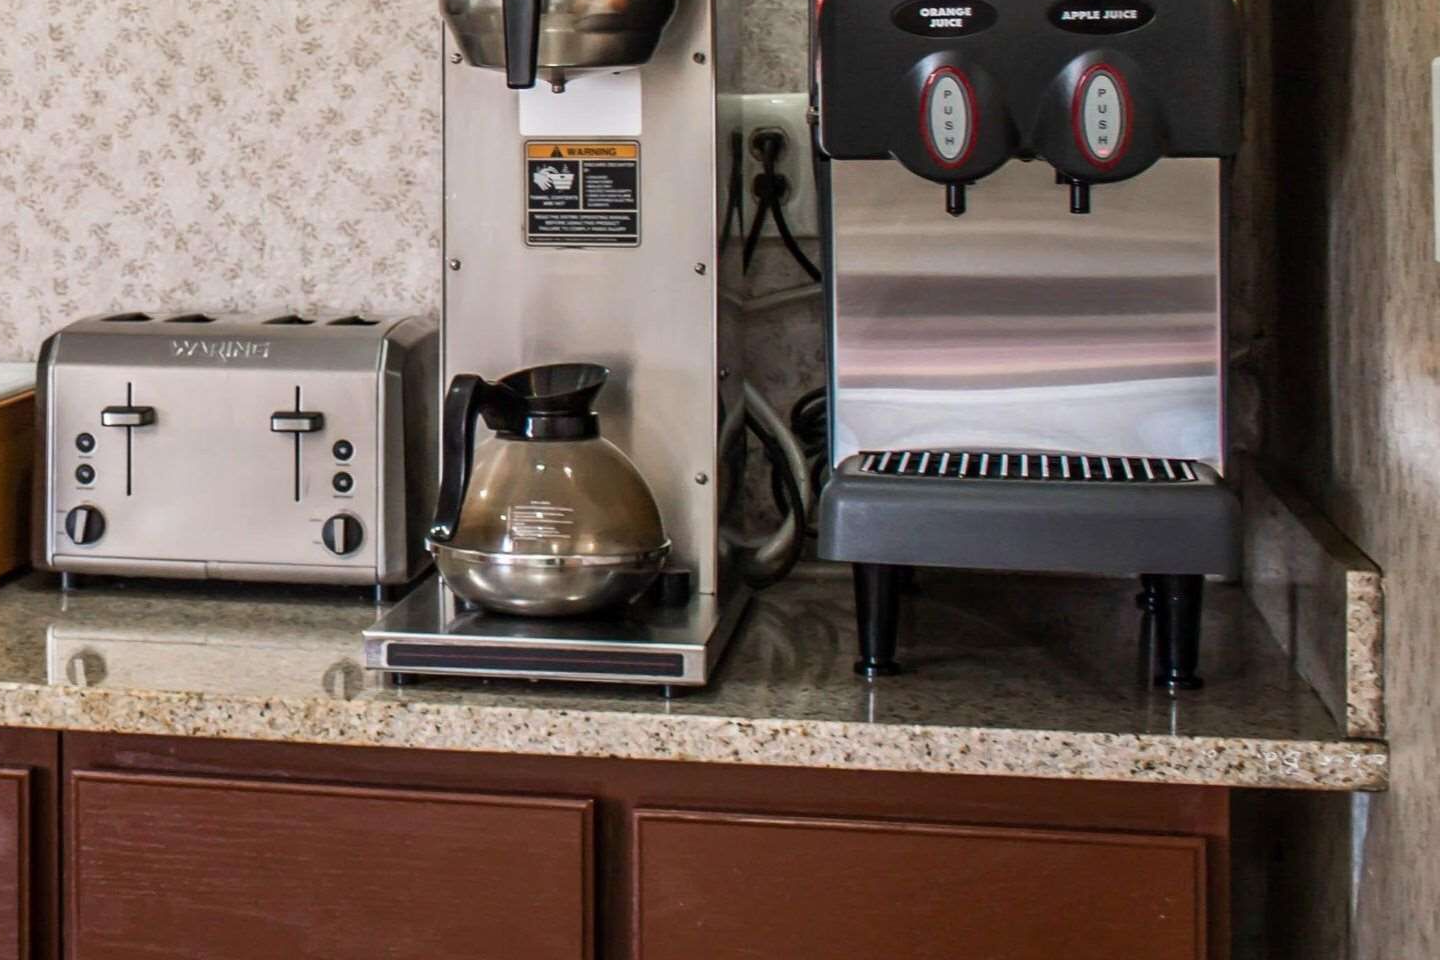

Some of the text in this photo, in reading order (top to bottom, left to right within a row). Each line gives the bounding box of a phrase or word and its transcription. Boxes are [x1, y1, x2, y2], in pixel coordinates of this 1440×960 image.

[919, 6, 972, 18] ORANGE
[1061, 9, 1138, 21] APPLE JUICE
[929, 17, 963, 28] JUICE
[942, 88, 956, 147] PUSH
[1096, 87, 1110, 147] PUSH
